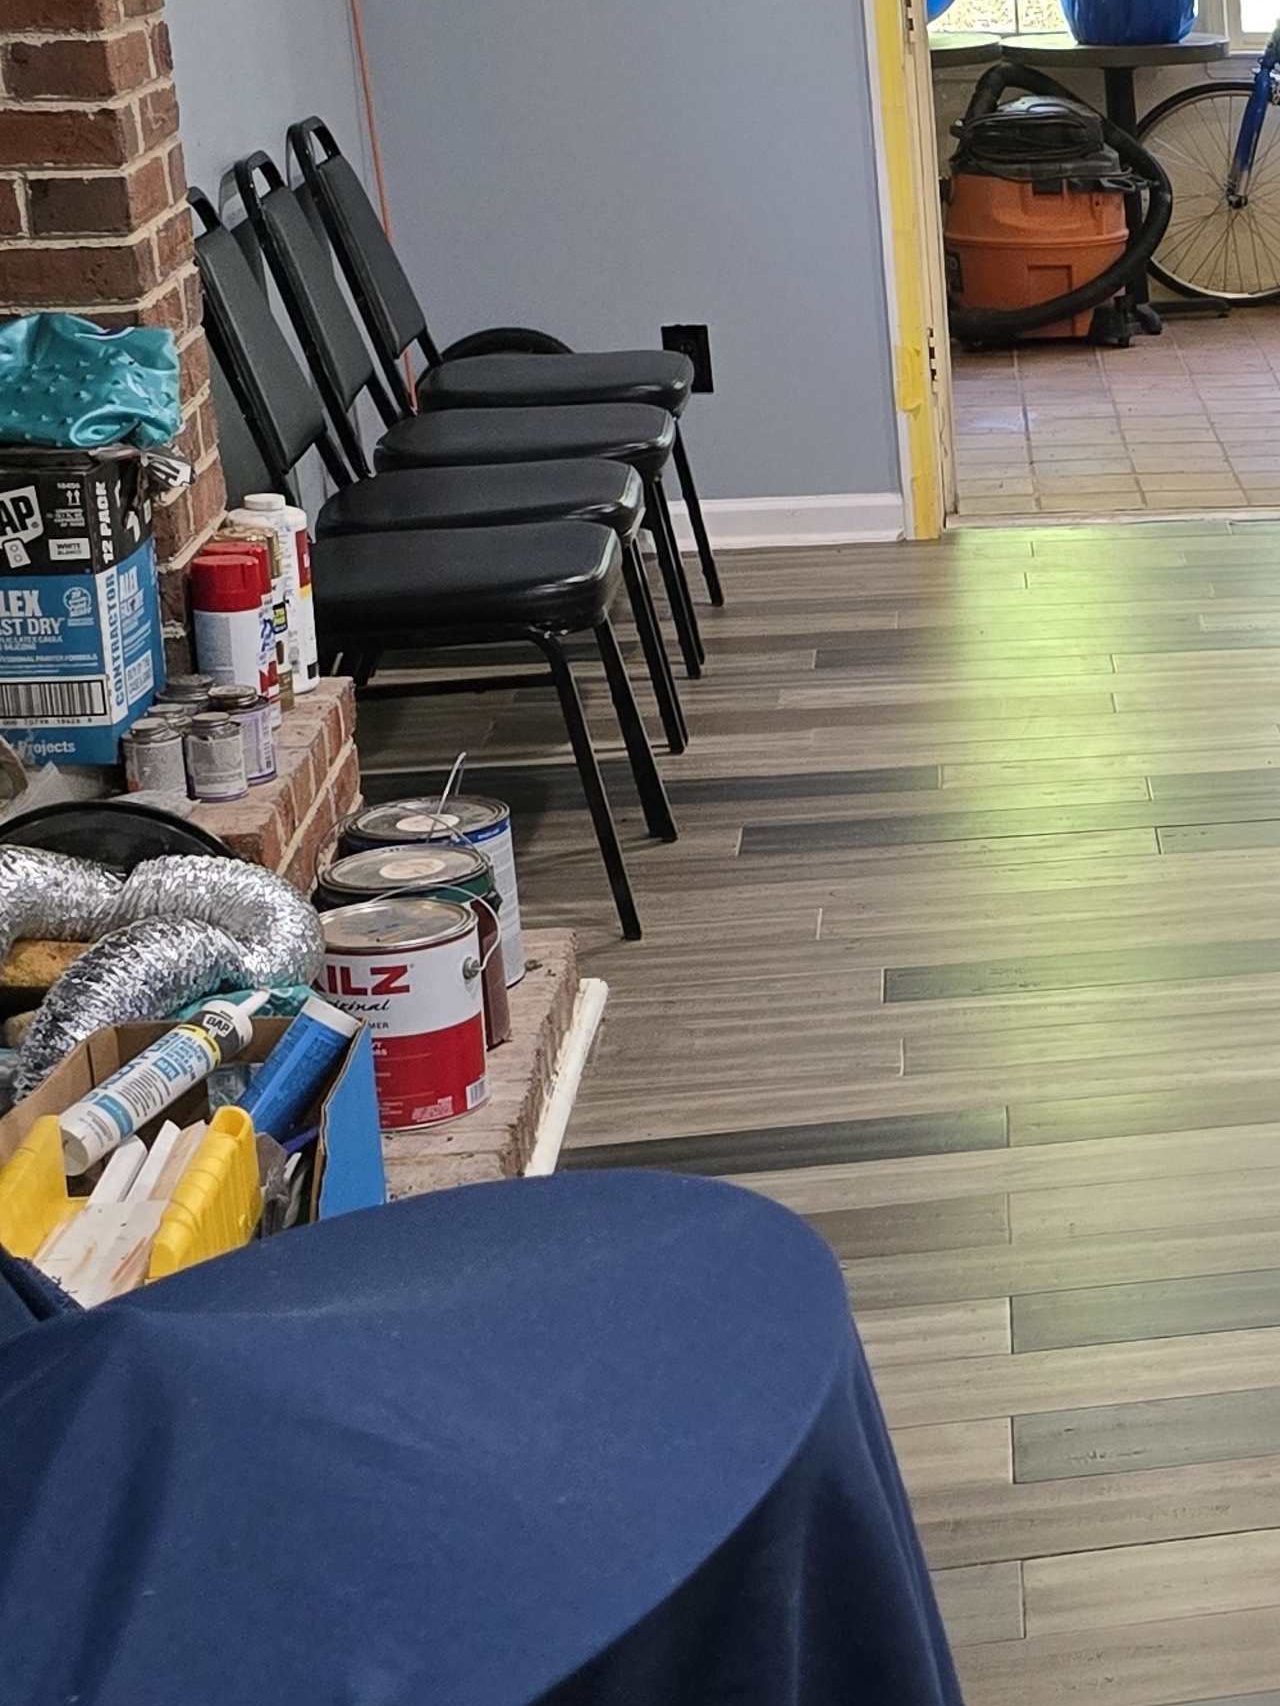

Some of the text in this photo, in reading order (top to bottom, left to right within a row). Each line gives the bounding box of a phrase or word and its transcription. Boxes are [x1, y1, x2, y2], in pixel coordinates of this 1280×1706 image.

[0, 495, 35, 536] AP
[95, 481, 114, 564] 12 PACK
[0, 589, 43, 617] LEX
[0, 617, 61, 637] ST DRY
[105, 574, 124, 706] CONTRACTOR
[206, 1015, 230, 1033] DAP
